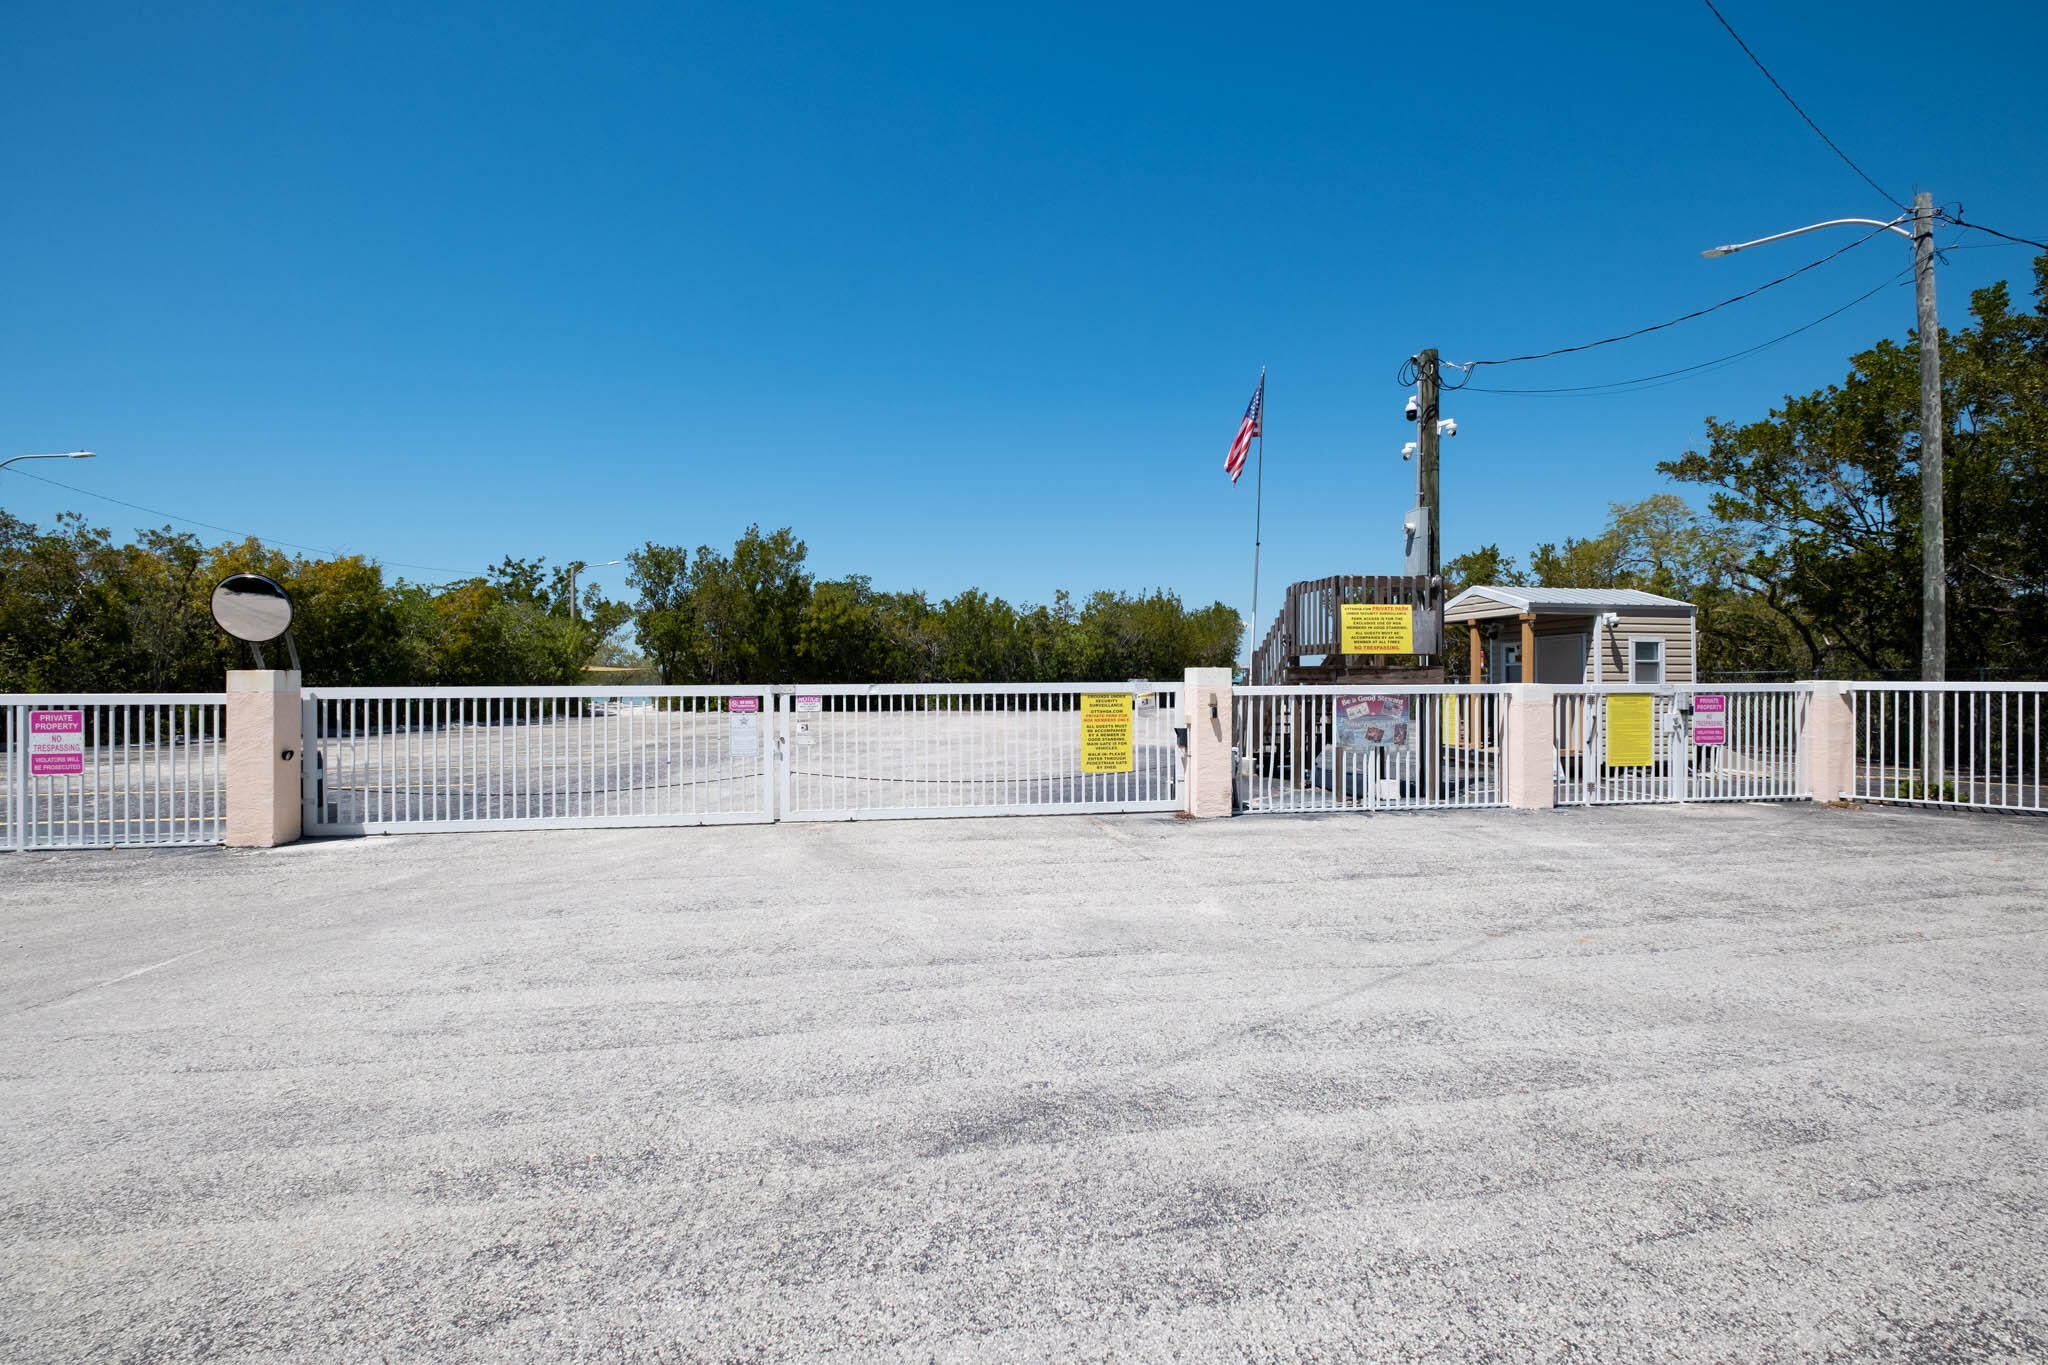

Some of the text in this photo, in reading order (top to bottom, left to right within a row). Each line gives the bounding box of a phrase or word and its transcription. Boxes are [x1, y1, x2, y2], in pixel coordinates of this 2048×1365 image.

[1377, 696, 1403, 704] Steward
[51, 735, 62, 743] NO
[33, 744, 80, 752] TRESPASSING
